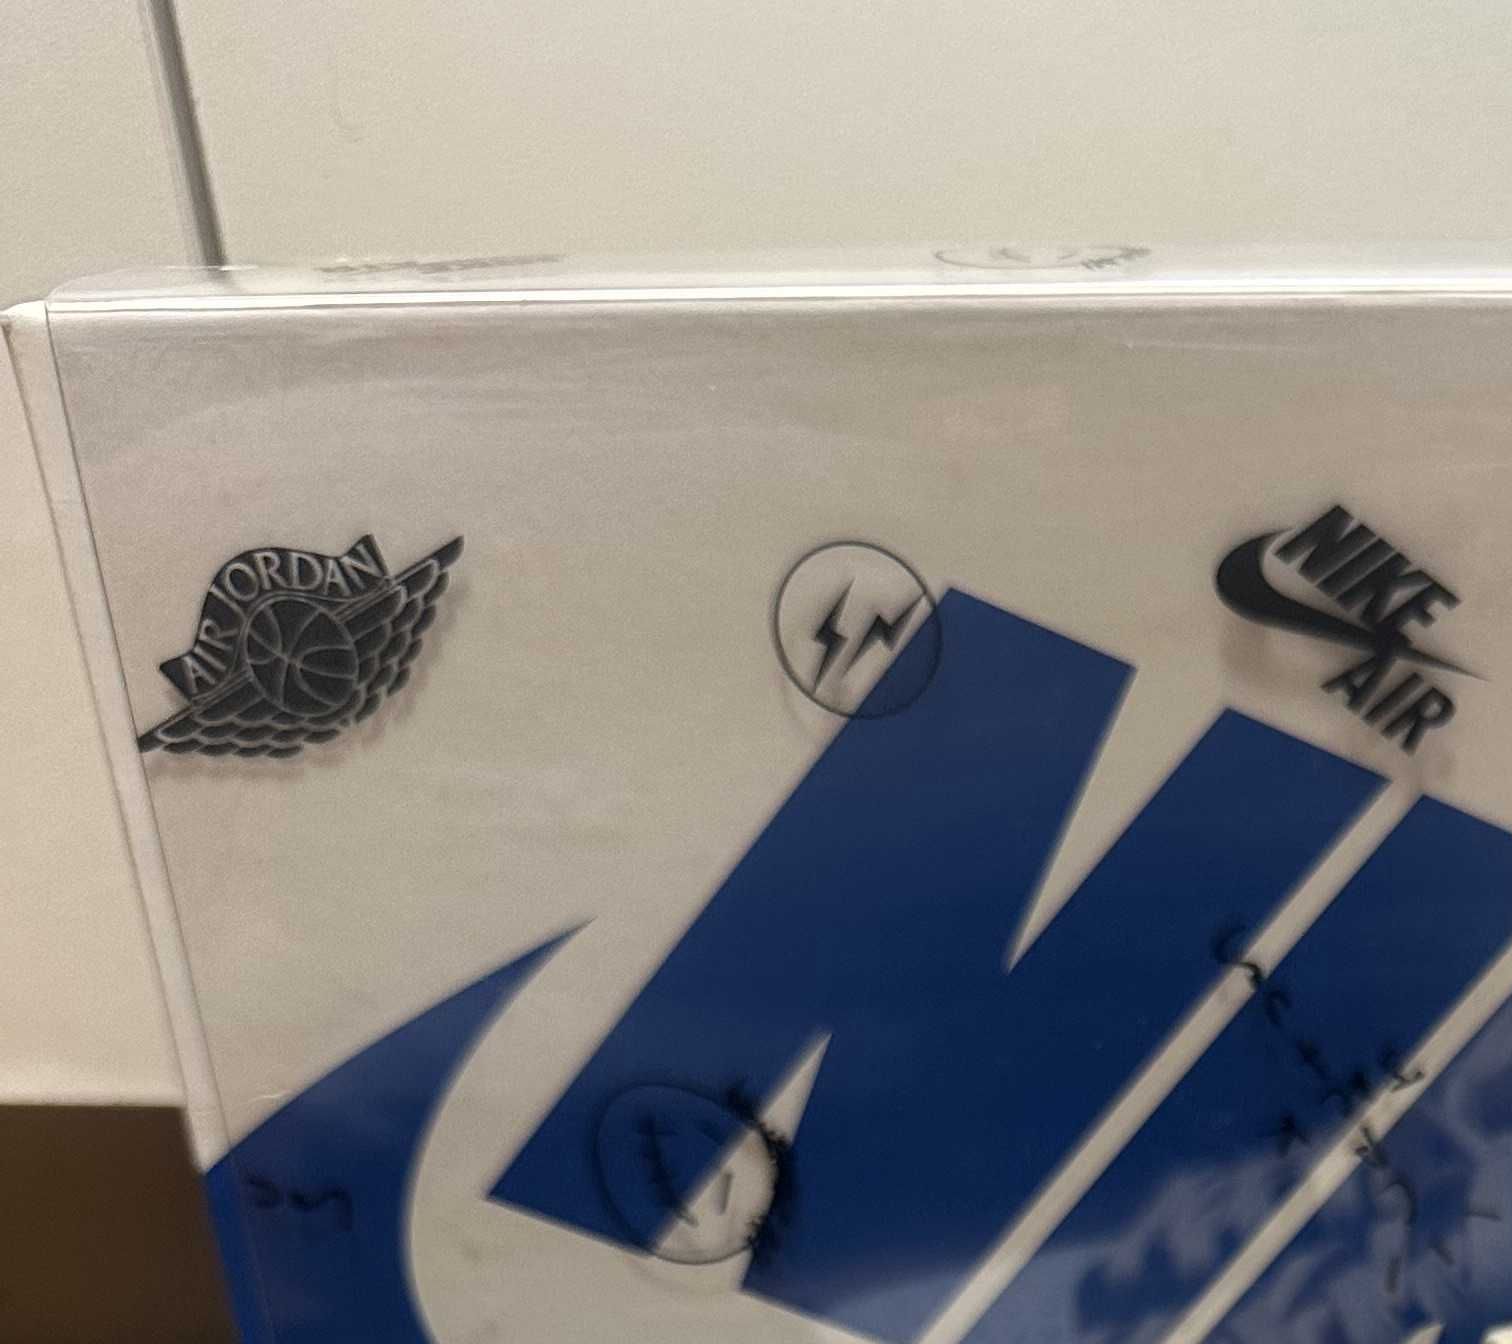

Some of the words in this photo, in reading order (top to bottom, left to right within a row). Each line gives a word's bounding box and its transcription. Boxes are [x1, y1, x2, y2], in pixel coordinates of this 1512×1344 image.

[210, 542, 388, 624] JORDAN
[1272, 504, 1462, 647] NIKE
[184, 617, 243, 696] AIR
[1319, 654, 1457, 758] AIR
